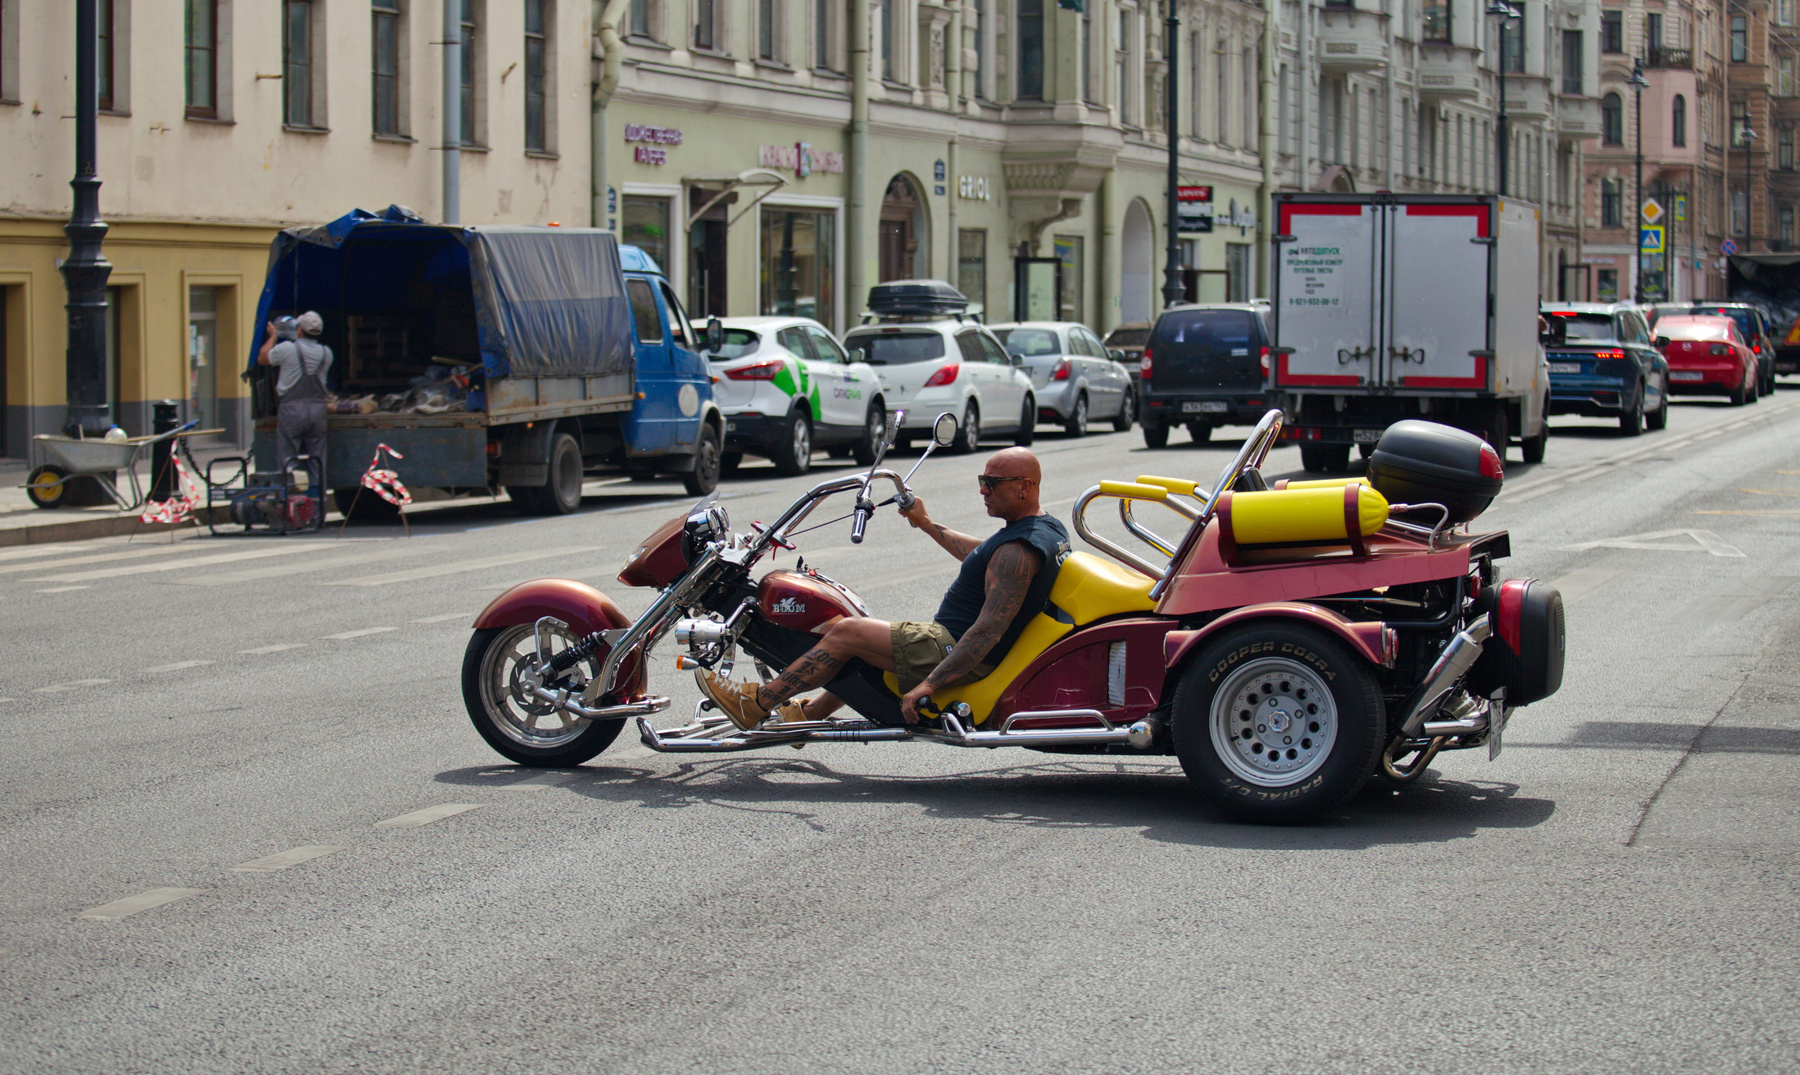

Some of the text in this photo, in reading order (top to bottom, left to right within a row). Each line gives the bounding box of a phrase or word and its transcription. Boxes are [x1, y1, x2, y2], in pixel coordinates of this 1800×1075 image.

[772, 603, 806, 613] BOOM
[1209, 641, 1337, 683] COOPER COBRA
[1257, 774, 1323, 801] RADIAL
